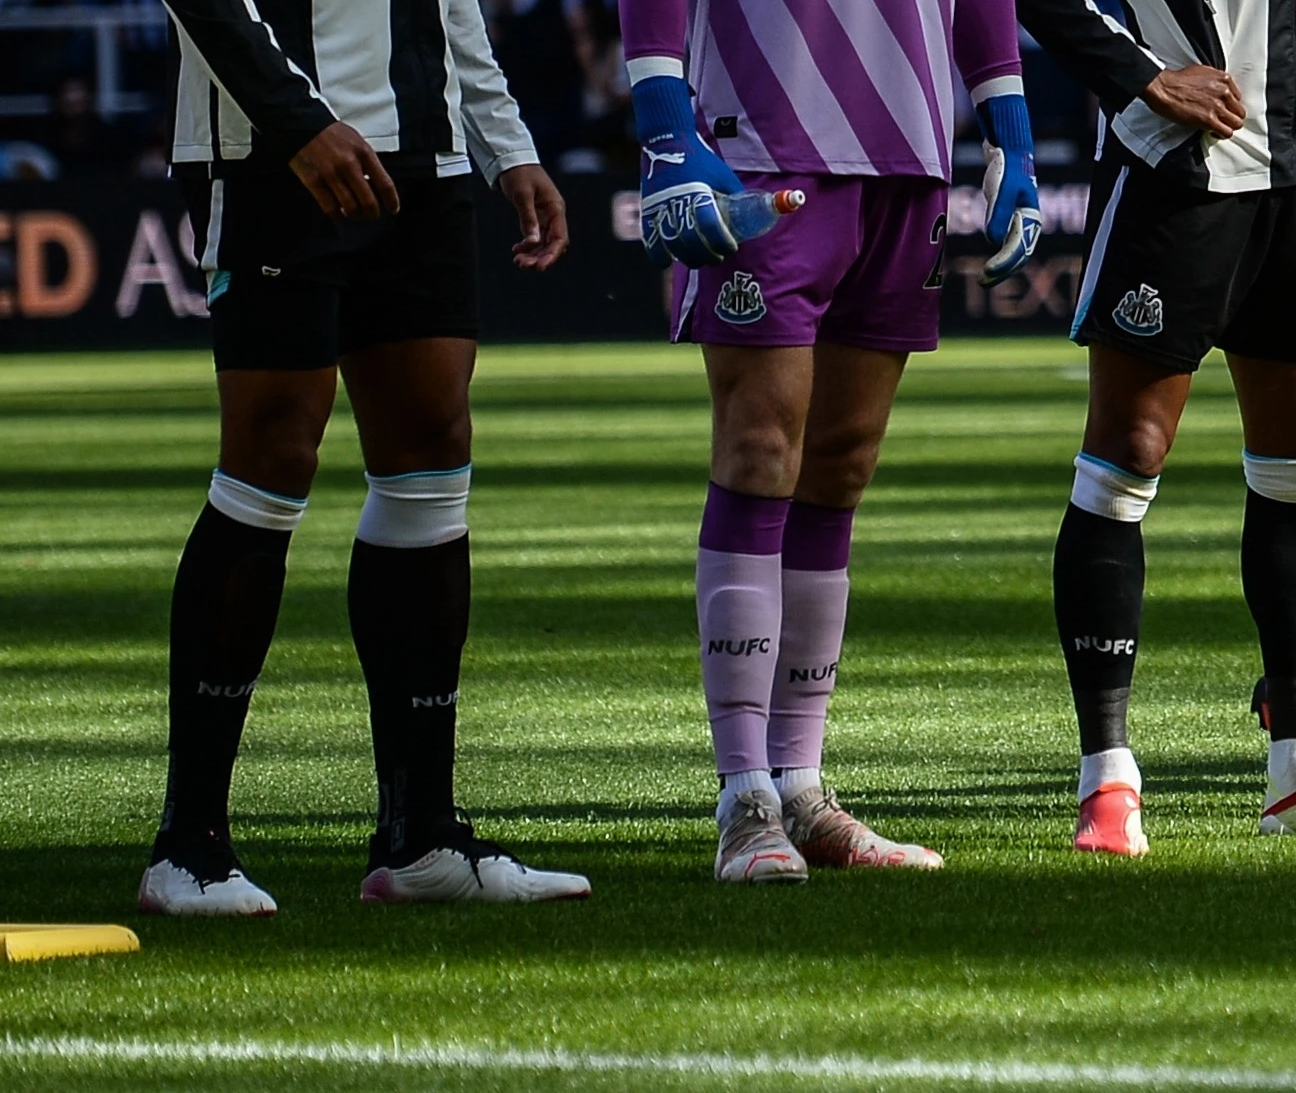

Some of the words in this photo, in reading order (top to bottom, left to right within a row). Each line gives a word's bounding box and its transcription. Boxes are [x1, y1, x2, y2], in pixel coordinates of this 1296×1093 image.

[707, 637, 770, 656] NUFC
[1073, 634, 1136, 657] NUFC
[789, 663, 838, 683] NUF
